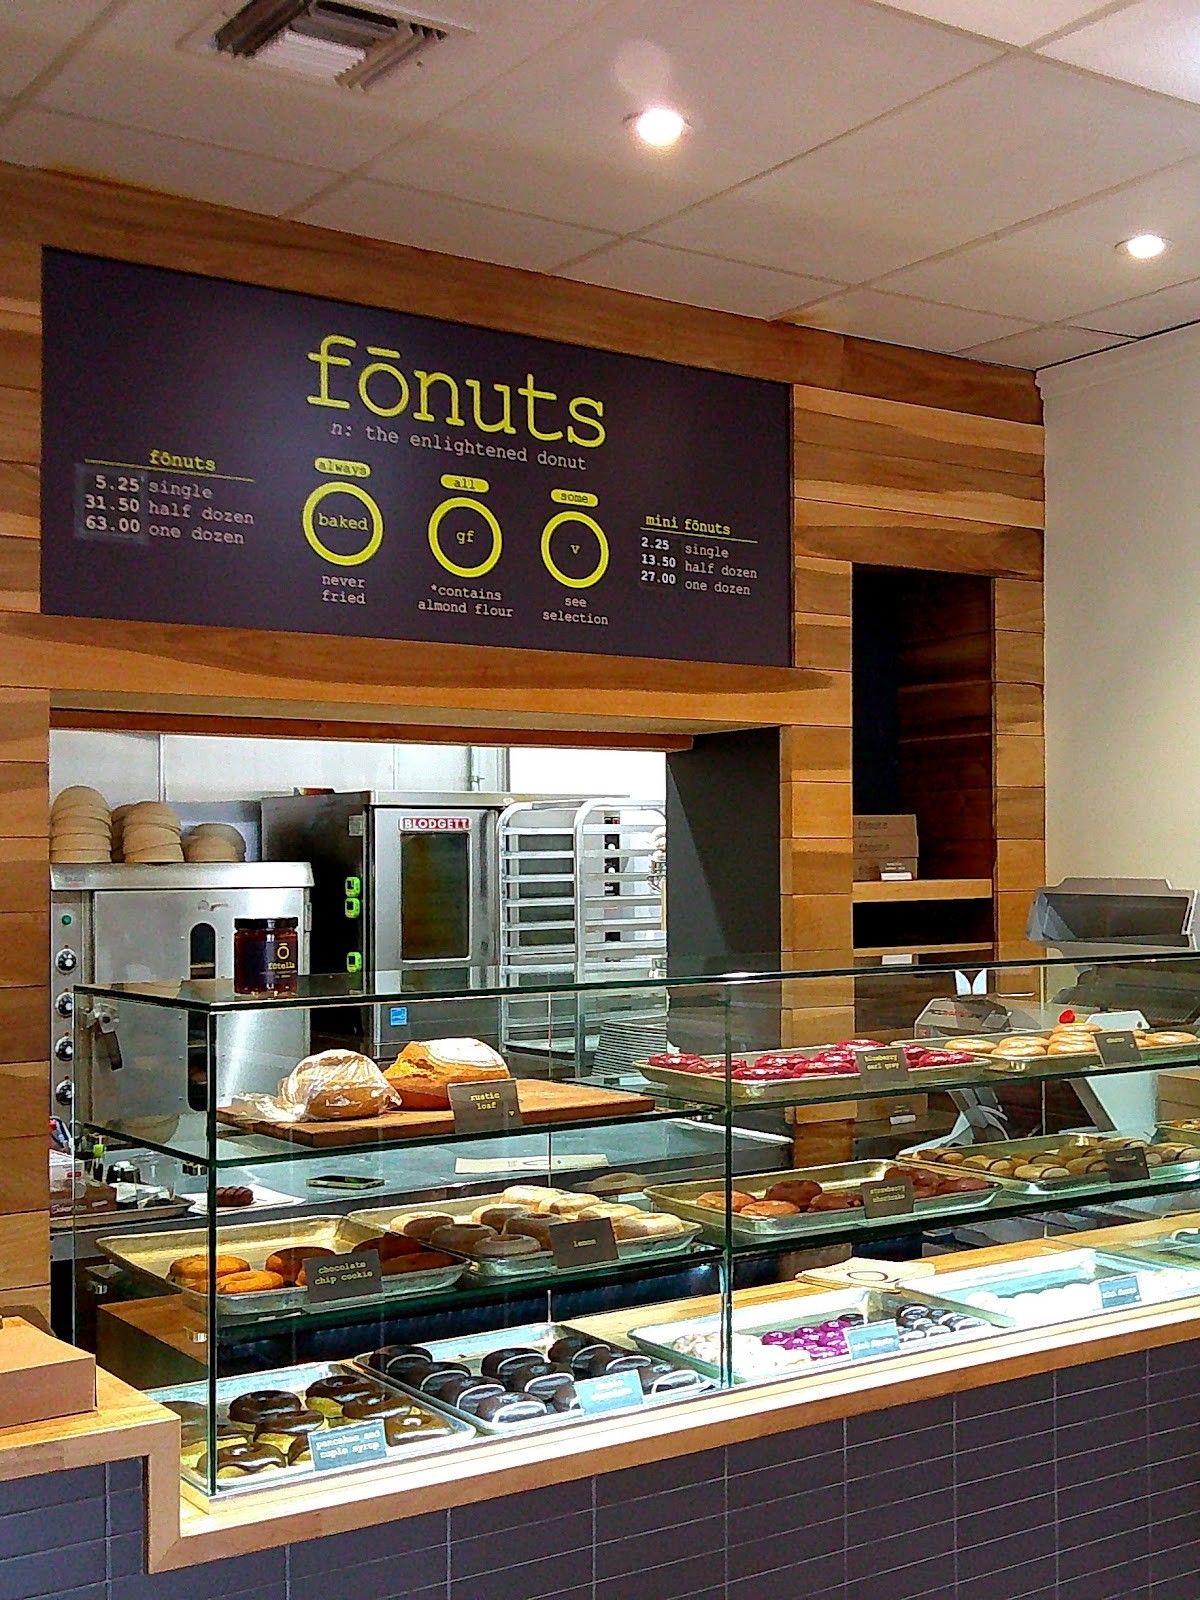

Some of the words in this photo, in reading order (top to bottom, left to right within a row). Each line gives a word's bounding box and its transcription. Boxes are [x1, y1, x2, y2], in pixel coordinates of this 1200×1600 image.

[307, 334, 606, 449] fōnuts
[330, 421, 352, 438] n:
[365, 424, 399, 444] the
[409, 431, 529, 462] enlightened
[537, 450, 588, 471] donut
[318, 461, 367, 477] always
[95, 474, 140, 493] 5.25
[148, 480, 214, 500] single
[453, 478, 477, 490] all
[560, 491, 589, 504] some
[84, 494, 140, 513] 31.50
[148, 500, 192, 519] half
[201, 507, 255, 526] dozen
[318, 512, 370, 531] baked
[645, 514, 678, 529] mini
[85, 515, 141, 534] 63.00
[149, 523, 182, 539] one
[191, 526, 245, 545] dozen
[456, 530, 475, 545] gf
[570, 544, 581, 555] v
[641, 536, 670, 551] 2.25
[684, 543, 729, 559] single
[641, 553, 676, 569] 13.50
[684, 560, 715, 574] half
[720, 564, 758, 579] dozen
[321, 575, 366, 589] never
[640, 569, 676, 585] 27.00
[684, 579, 708, 591] one
[714, 581, 751, 595] dozen
[322, 589, 366, 605] fried
[564, 596, 587, 608] see
[417, 598, 468, 614] almond
[474, 603, 514, 618] flour
[542, 609, 609, 626] selection
[404, 818, 468, 830] BLODGETT
[470, 1092, 501, 1101] rustic
[476, 1101, 497, 1110] loaf
[318, 1261, 366, 1274] chocolate
[314, 1276, 337, 1285] chip
[340, 1271, 373, 1281] cookie
[352, 1441, 380, 1454] syrup
